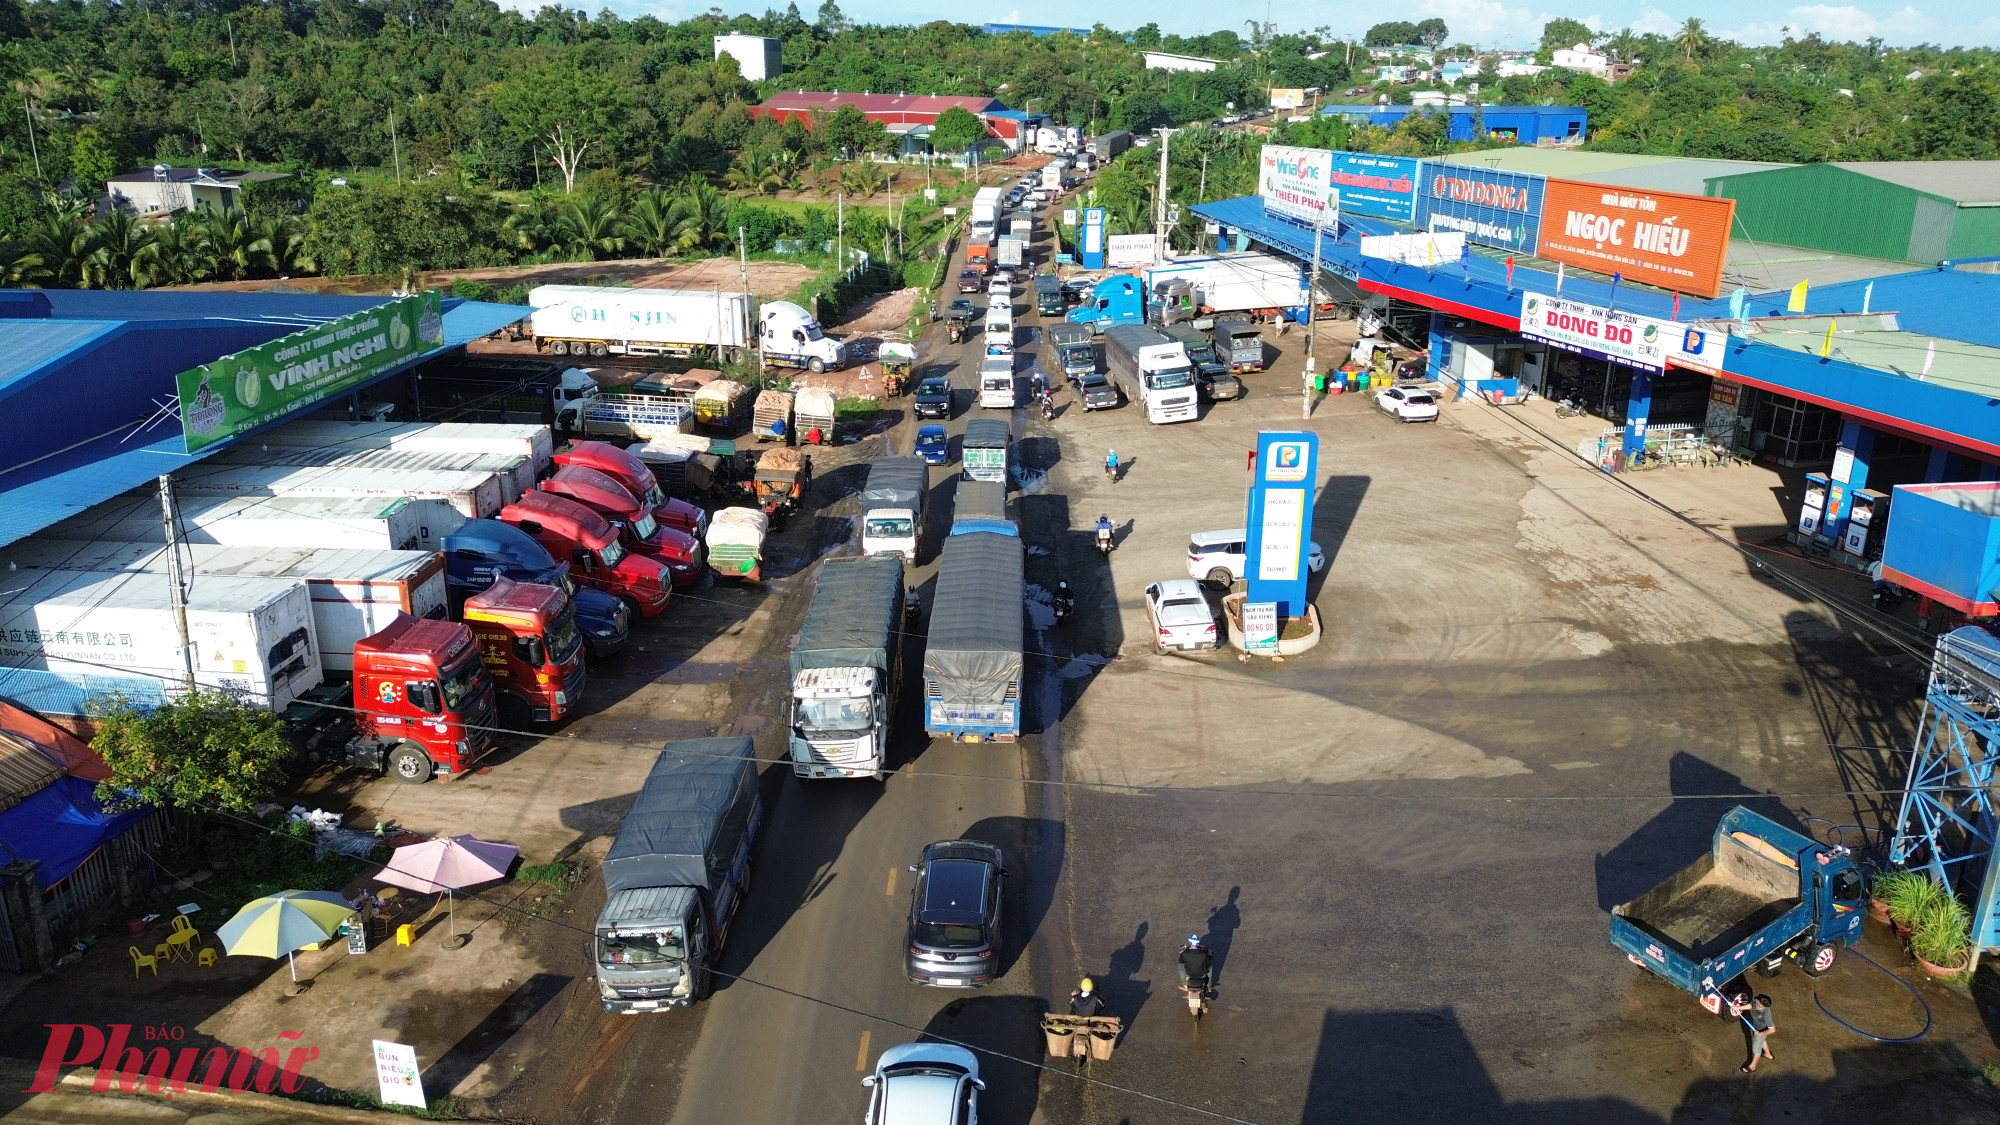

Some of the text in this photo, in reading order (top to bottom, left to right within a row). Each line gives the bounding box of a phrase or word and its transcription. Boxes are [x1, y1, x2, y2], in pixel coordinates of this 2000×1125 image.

[1601, 192, 1656, 212] NHÀ MÁY TÔN
[1461, 217, 1476, 234] HIỆU
[1477, 222, 1498, 239] QUỐC
[1498, 228, 1512, 242] GIA
[1565, 210, 1690, 257] NGỌC HIẾU
[591, 308, 678, 325] HNJIN
[1522, 316, 1540, 328] 云果飞
[1560, 302, 1568, 312] TY
[1569, 303, 1585, 314] TNHH
[1591, 309, 1604, 318] XNK
[1623, 312, 1638, 325] SẢN
[1546, 310, 1633, 345] ĐÔNG ĐÔ
[274, 316, 379, 362] CÔNG TY TNHH THỰC PHẨM
[1637, 343, 1660, 358] 云果飞
[1676, 351, 1709, 364] PETROLIMEX
[269, 354, 330, 391] VĨNH
[332, 333, 387, 368] NGHI
[66, 650, 101, 660] YUNNAN
[612, 975, 674, 985] LUXURY
